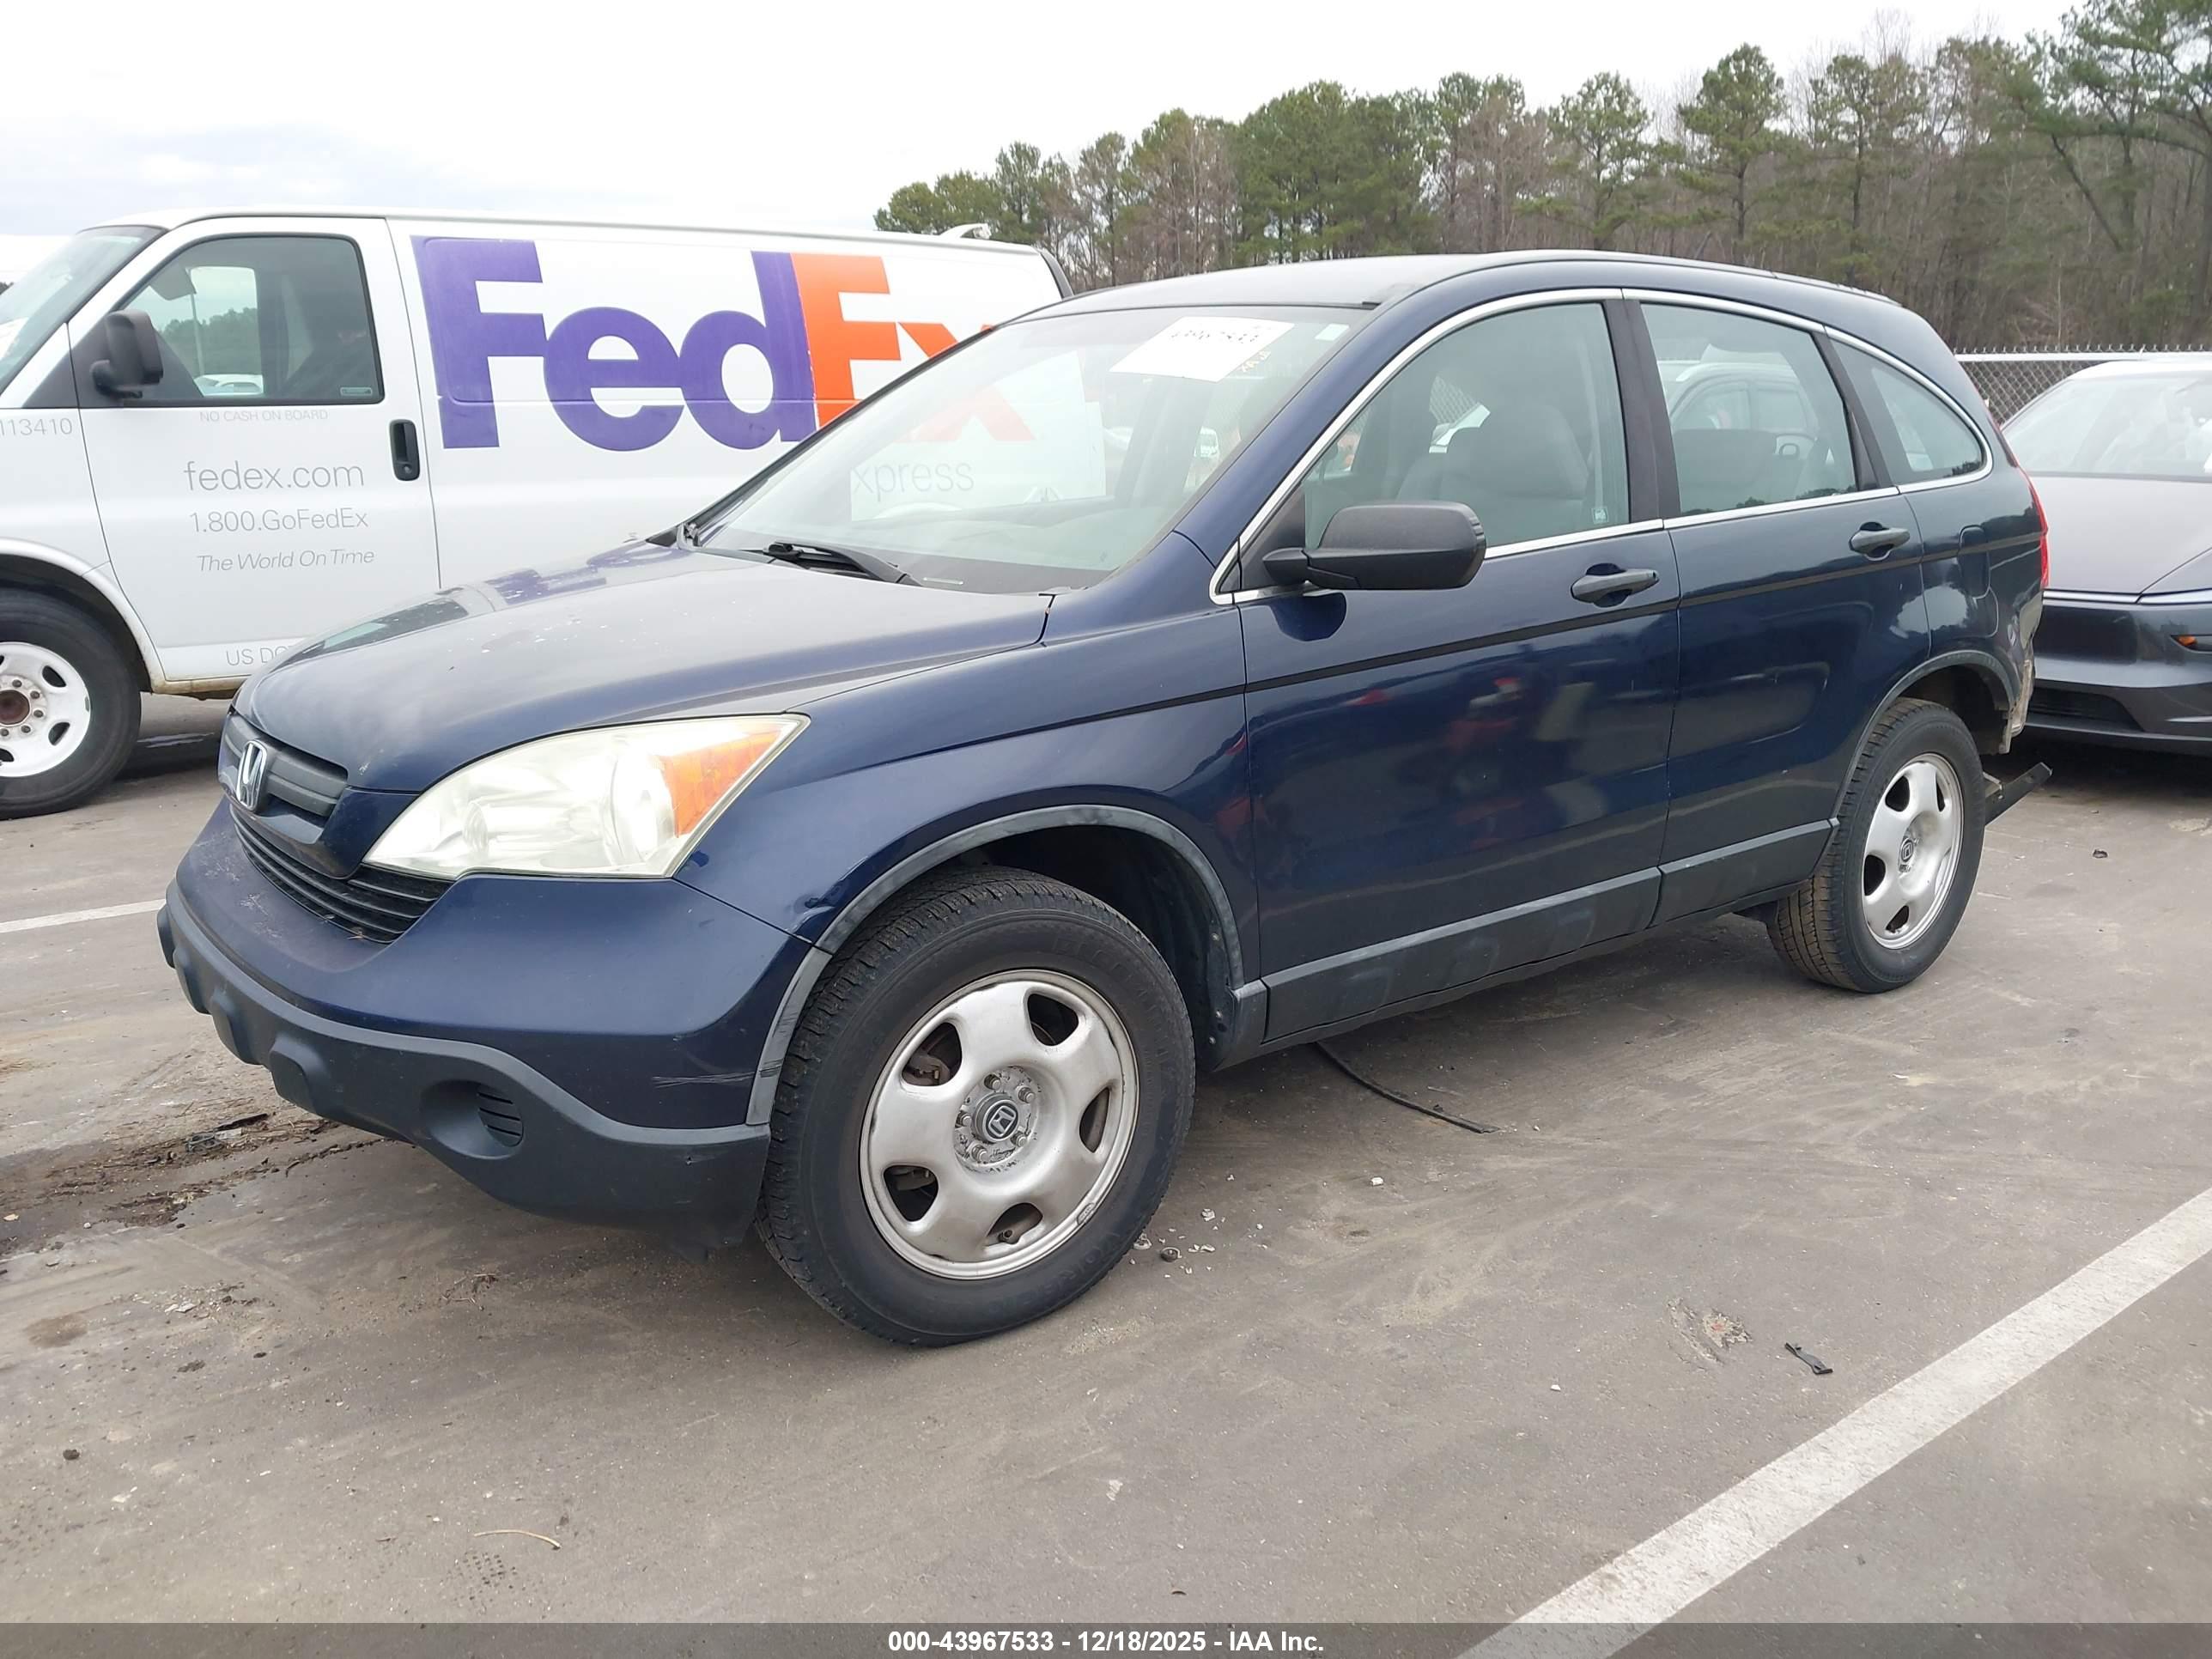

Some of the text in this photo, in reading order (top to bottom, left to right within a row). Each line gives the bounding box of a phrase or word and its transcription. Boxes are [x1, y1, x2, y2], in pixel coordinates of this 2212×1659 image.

[410, 235, 1034, 452] FedEx
[199, 409, 329, 422] NO CASH ON BOARD
[184, 460, 364, 490] fedex.com
[190, 507, 369, 532] 1.800.GoFedEx
[197, 549, 374, 571] The World On Time
[226, 648, 254, 666] US
